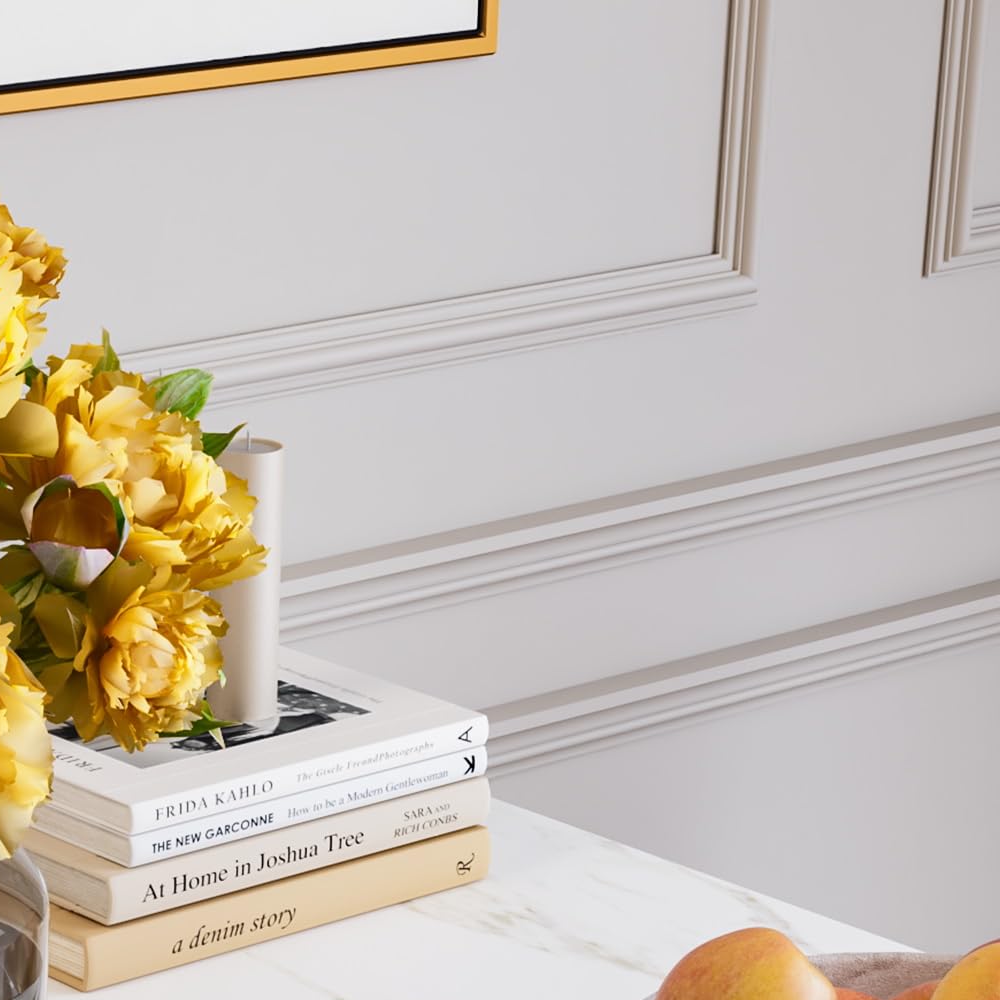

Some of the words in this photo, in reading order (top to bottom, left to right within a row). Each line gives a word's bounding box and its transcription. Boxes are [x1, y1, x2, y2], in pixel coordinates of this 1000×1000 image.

[287, 807, 310, 819] How
[313, 803, 323, 812] to
[325, 799, 337, 810] be
[347, 786, 384, 804] Modern
[385, 769, 449, 794] Gentlewoman
[296, 769, 313, 783] The
[155, 797, 208, 821] FRIDA
[215, 780, 273, 806] KAHLO
[403, 806, 433, 821] SARA
[152, 840, 172, 854] THE
[175, 832, 202, 848] NEW
[205, 812, 275, 840] GARCONNE
[393, 823, 420, 838] RICH
[142, 883, 165, 903] At
[172, 867, 228, 895] Home
[235, 860, 251, 878] in
[257, 844, 318, 871] Joshua
[323, 831, 365, 852] Tree
[172, 938, 183, 955] a
[189, 922, 245, 949] denim
[250, 906, 297, 932] story
